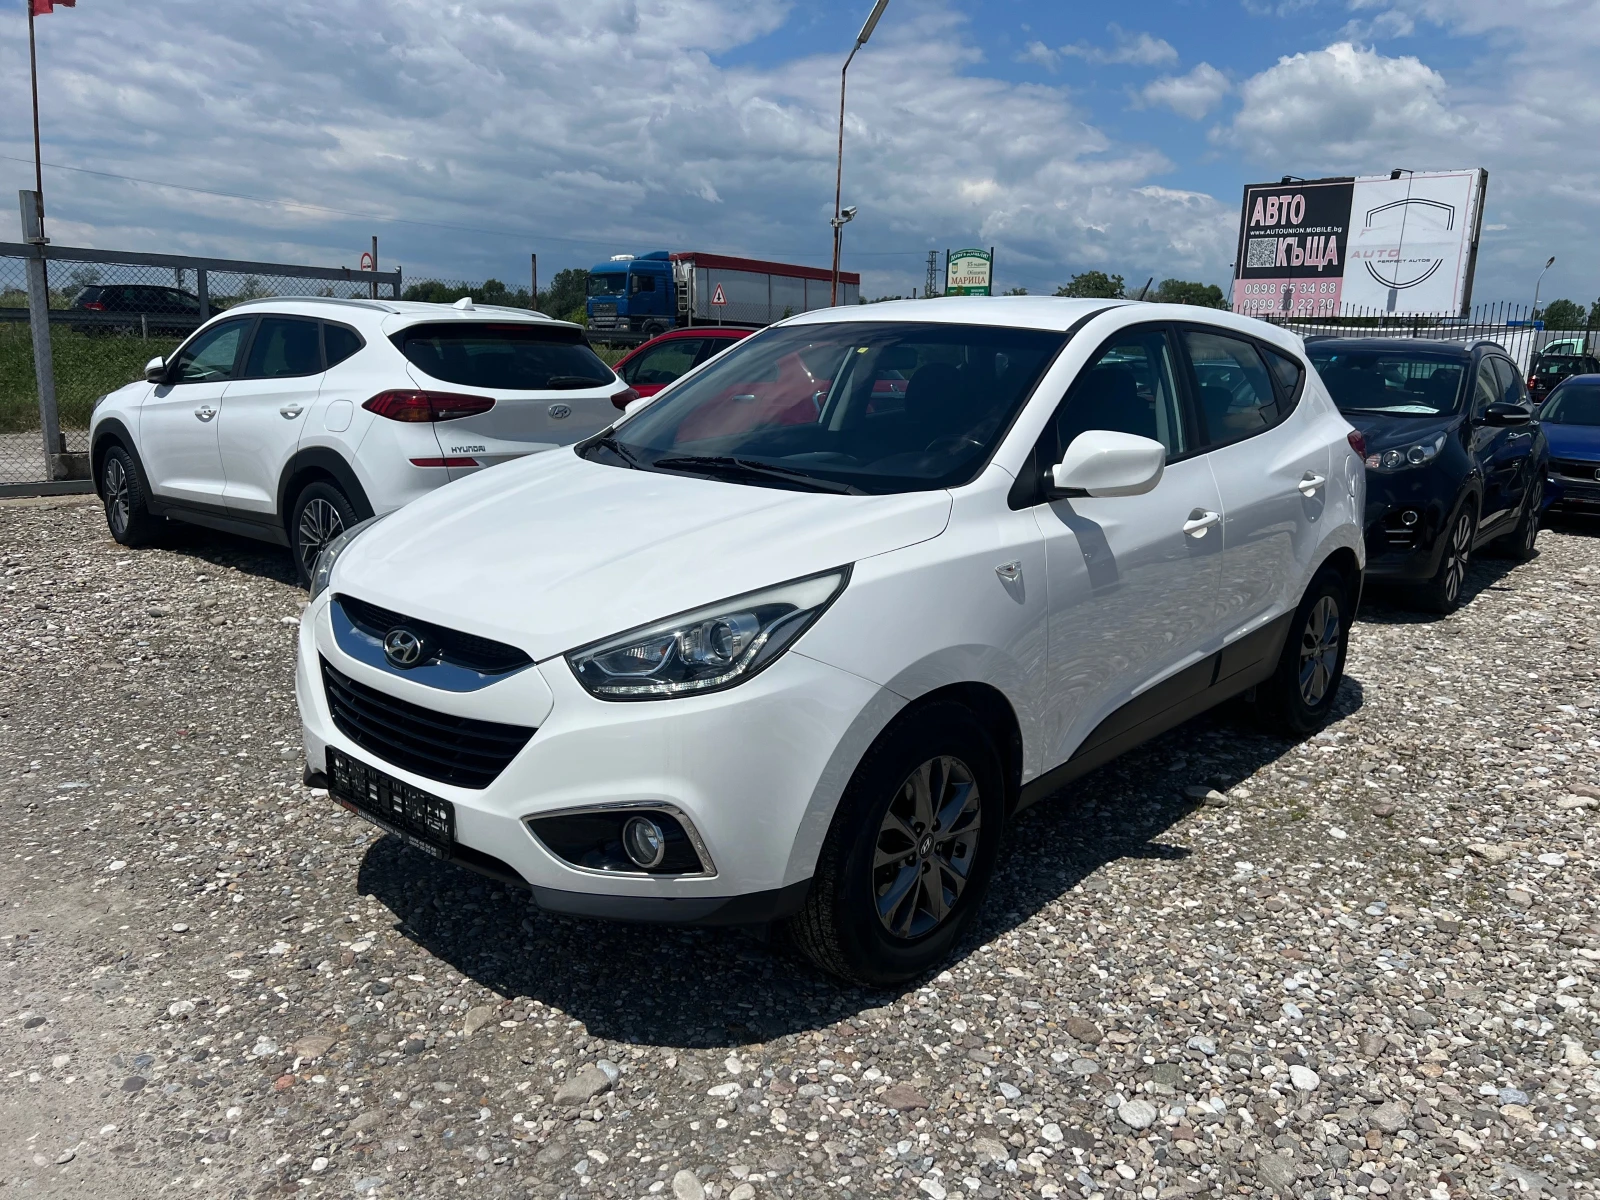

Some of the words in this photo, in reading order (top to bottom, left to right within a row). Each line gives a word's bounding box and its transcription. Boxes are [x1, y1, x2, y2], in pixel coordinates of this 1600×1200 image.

[1250, 194, 1305, 226] АВТО
[1250, 226, 1342, 236] www.AUTOUNION.MOBILE.bg
[1276, 235, 1338, 271] КЪЩА
[1350, 249, 1400, 259] AUTO
[951, 276, 985, 285] МАРИЦА
[1244, 283, 1276, 295] 0898
[1280, 283, 1296, 295] 65
[1299, 282, 1316, 294] 34
[1319, 282, 1336, 294] 88
[1243, 298, 1275, 310] 0899
[1278, 298, 1294, 310] 20
[1297, 298, 1314, 310] 22
[1317, 298, 1334, 310] 20
[451, 445, 486, 454] HYUNDAI
